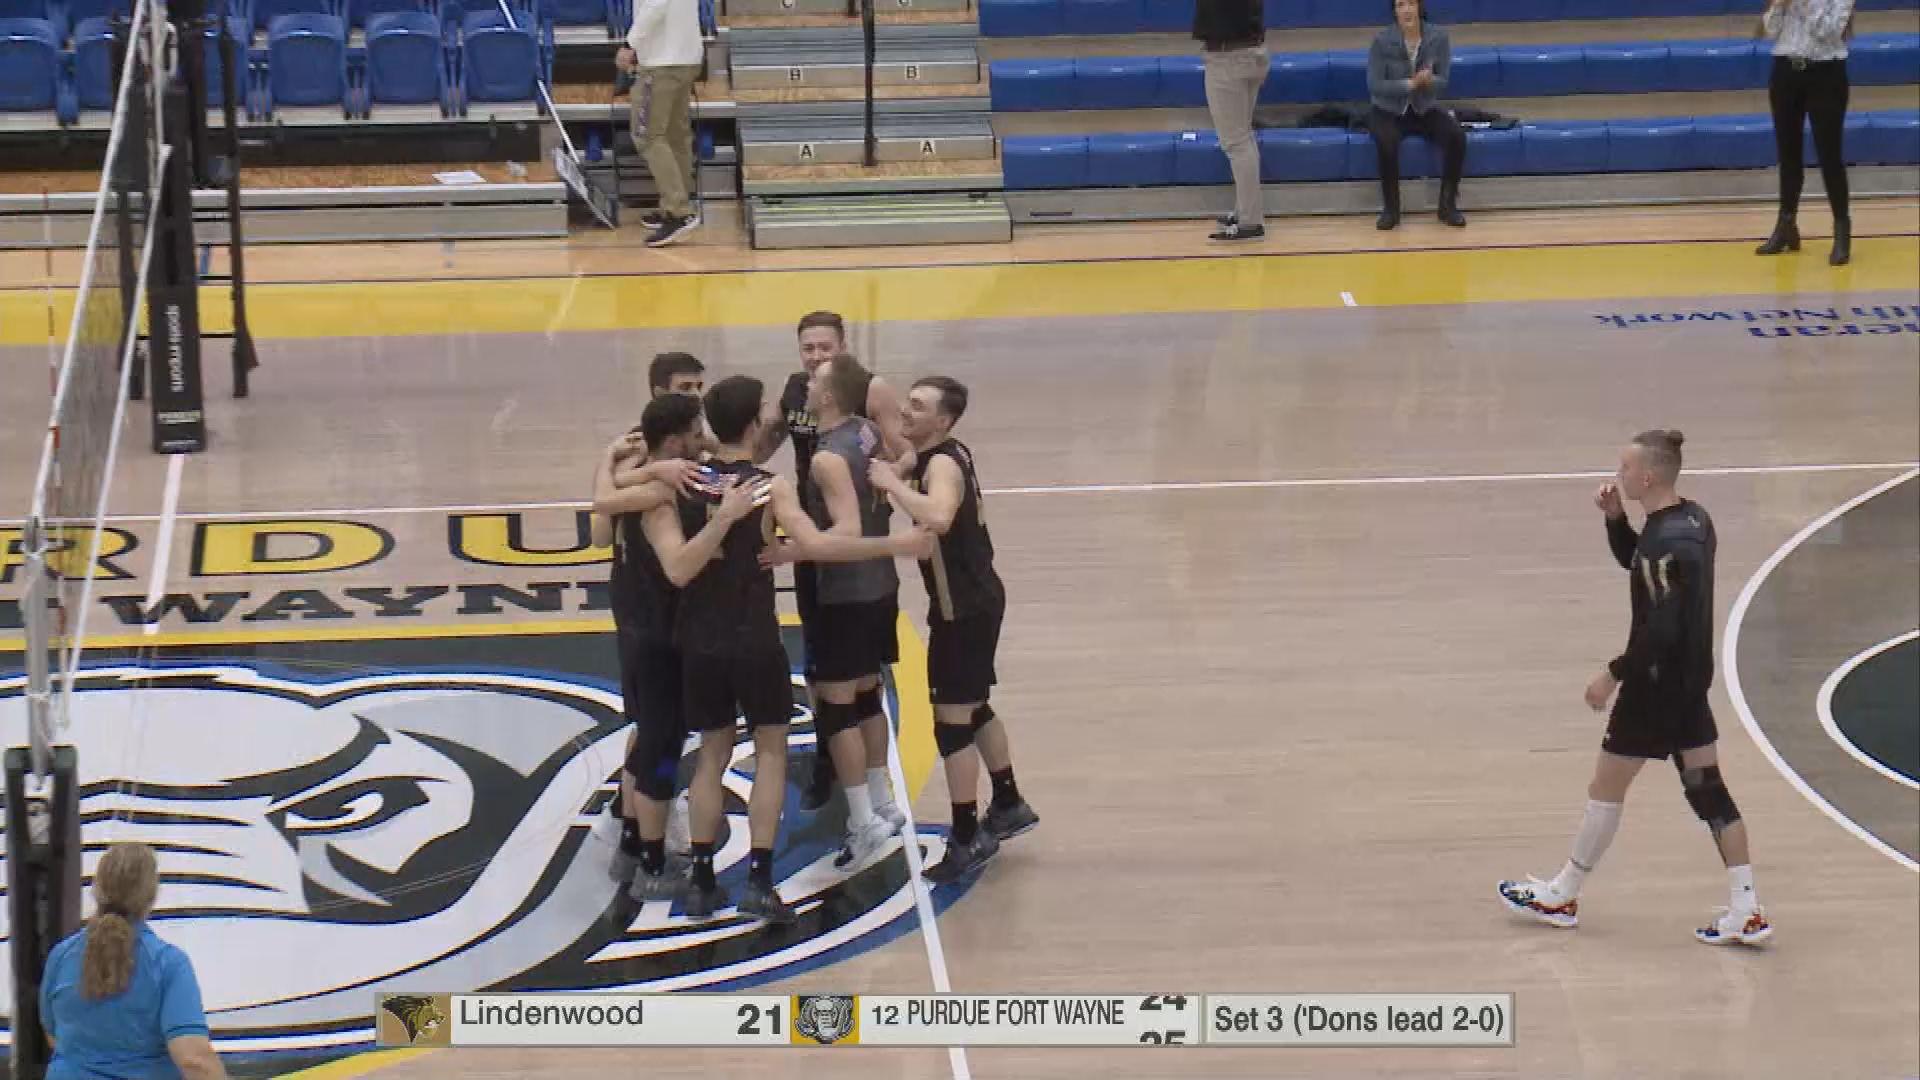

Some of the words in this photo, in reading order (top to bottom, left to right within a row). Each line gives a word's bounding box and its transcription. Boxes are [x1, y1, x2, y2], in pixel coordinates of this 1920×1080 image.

[906, 66, 918, 79] B
[801, 144, 812, 158] A
[922, 141, 934, 154] A
[1594, 308, 1840, 327] Network
[0, 511, 613, 584] RDU
